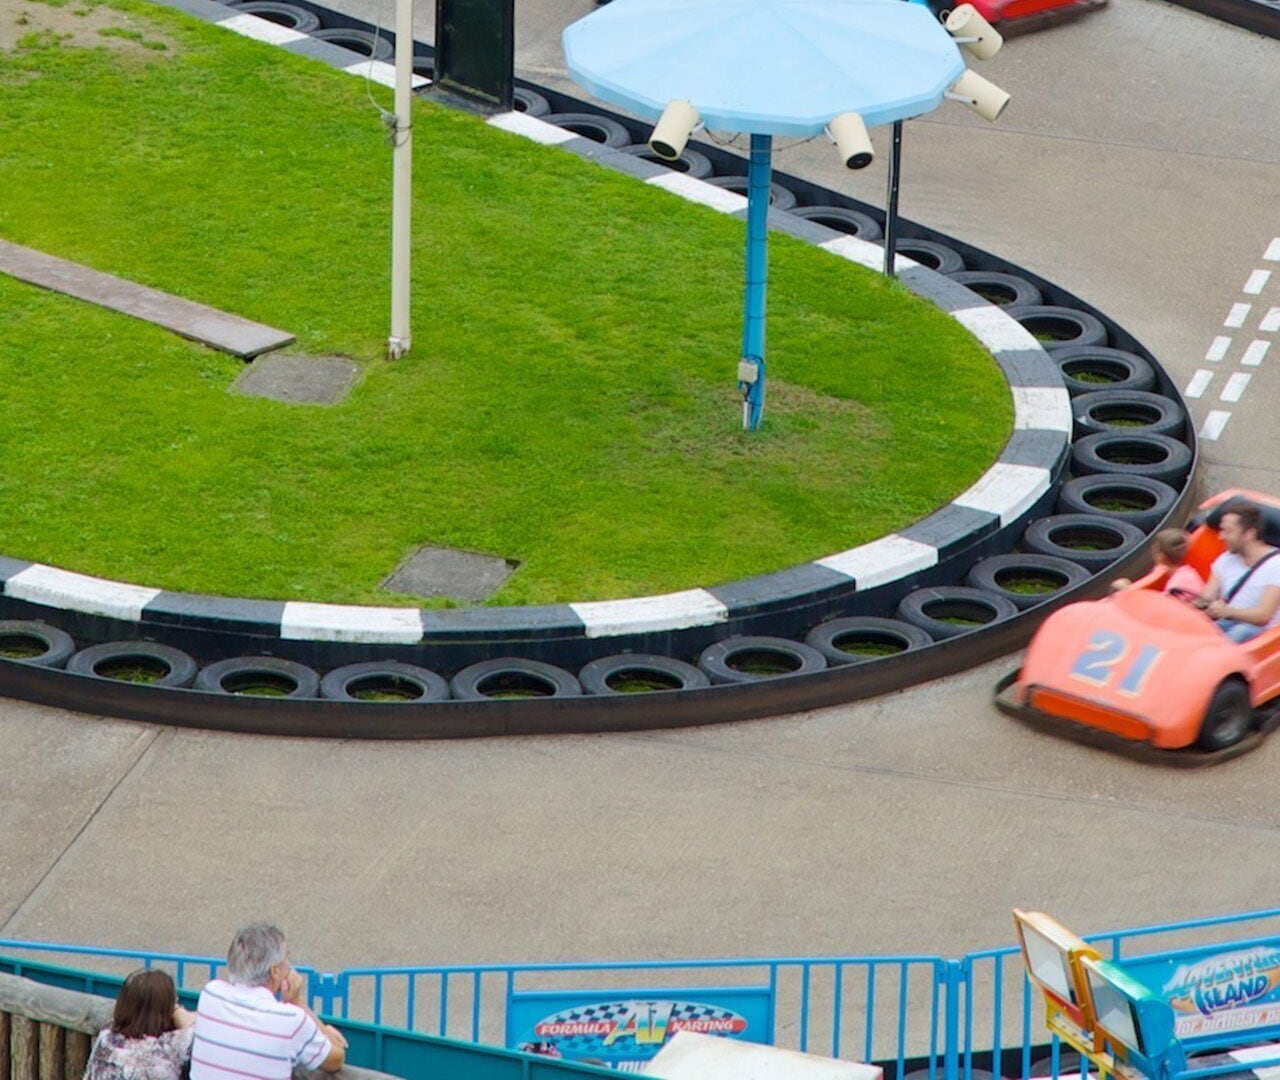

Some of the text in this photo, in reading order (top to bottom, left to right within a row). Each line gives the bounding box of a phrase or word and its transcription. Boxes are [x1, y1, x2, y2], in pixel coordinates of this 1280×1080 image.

[1067, 630, 1167, 698] 21
[1194, 975, 1270, 1016] ISLAND
[540, 1022, 612, 1036] FORMULA
[672, 1020, 734, 1033] KARTING
[1202, 1008, 1264, 1032] birthday
